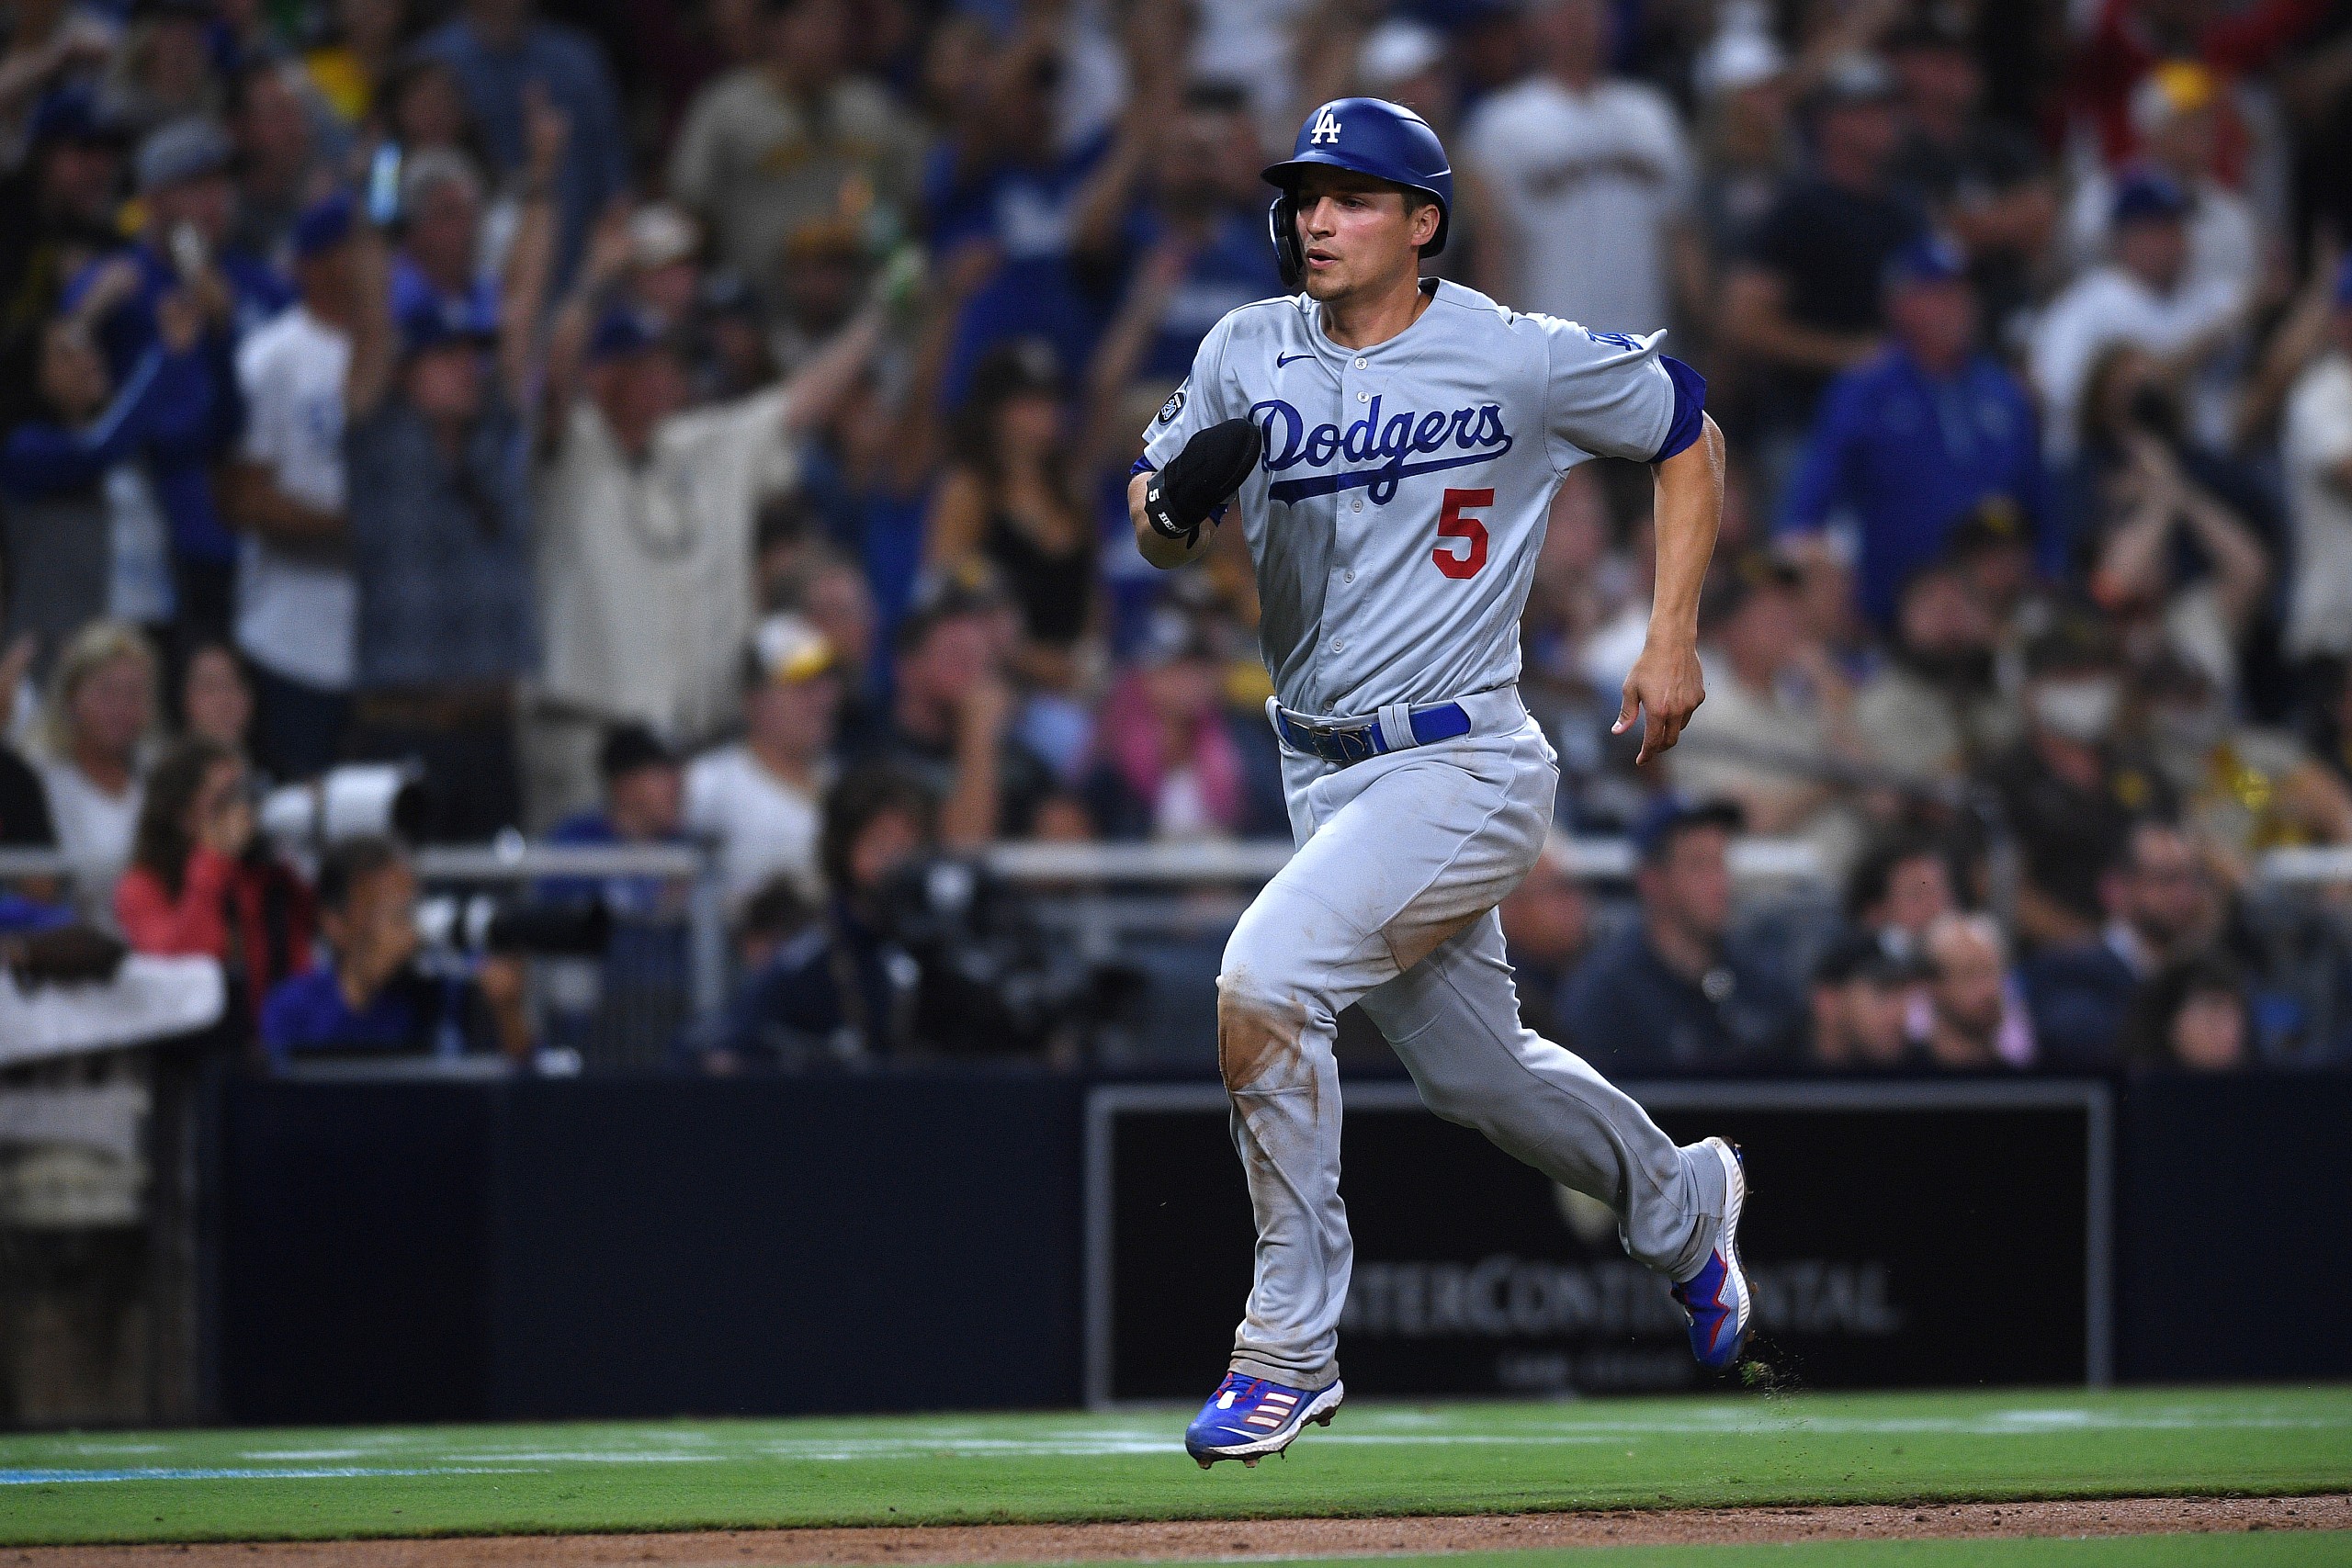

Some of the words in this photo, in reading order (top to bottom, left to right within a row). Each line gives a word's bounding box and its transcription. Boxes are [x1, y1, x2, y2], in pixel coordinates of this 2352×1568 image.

[1310, 106, 1341, 144] LA
[1248, 394, 1513, 505] Dodgers
[1148, 488, 1159, 502] 5
[1432, 488, 1495, 580] 5
